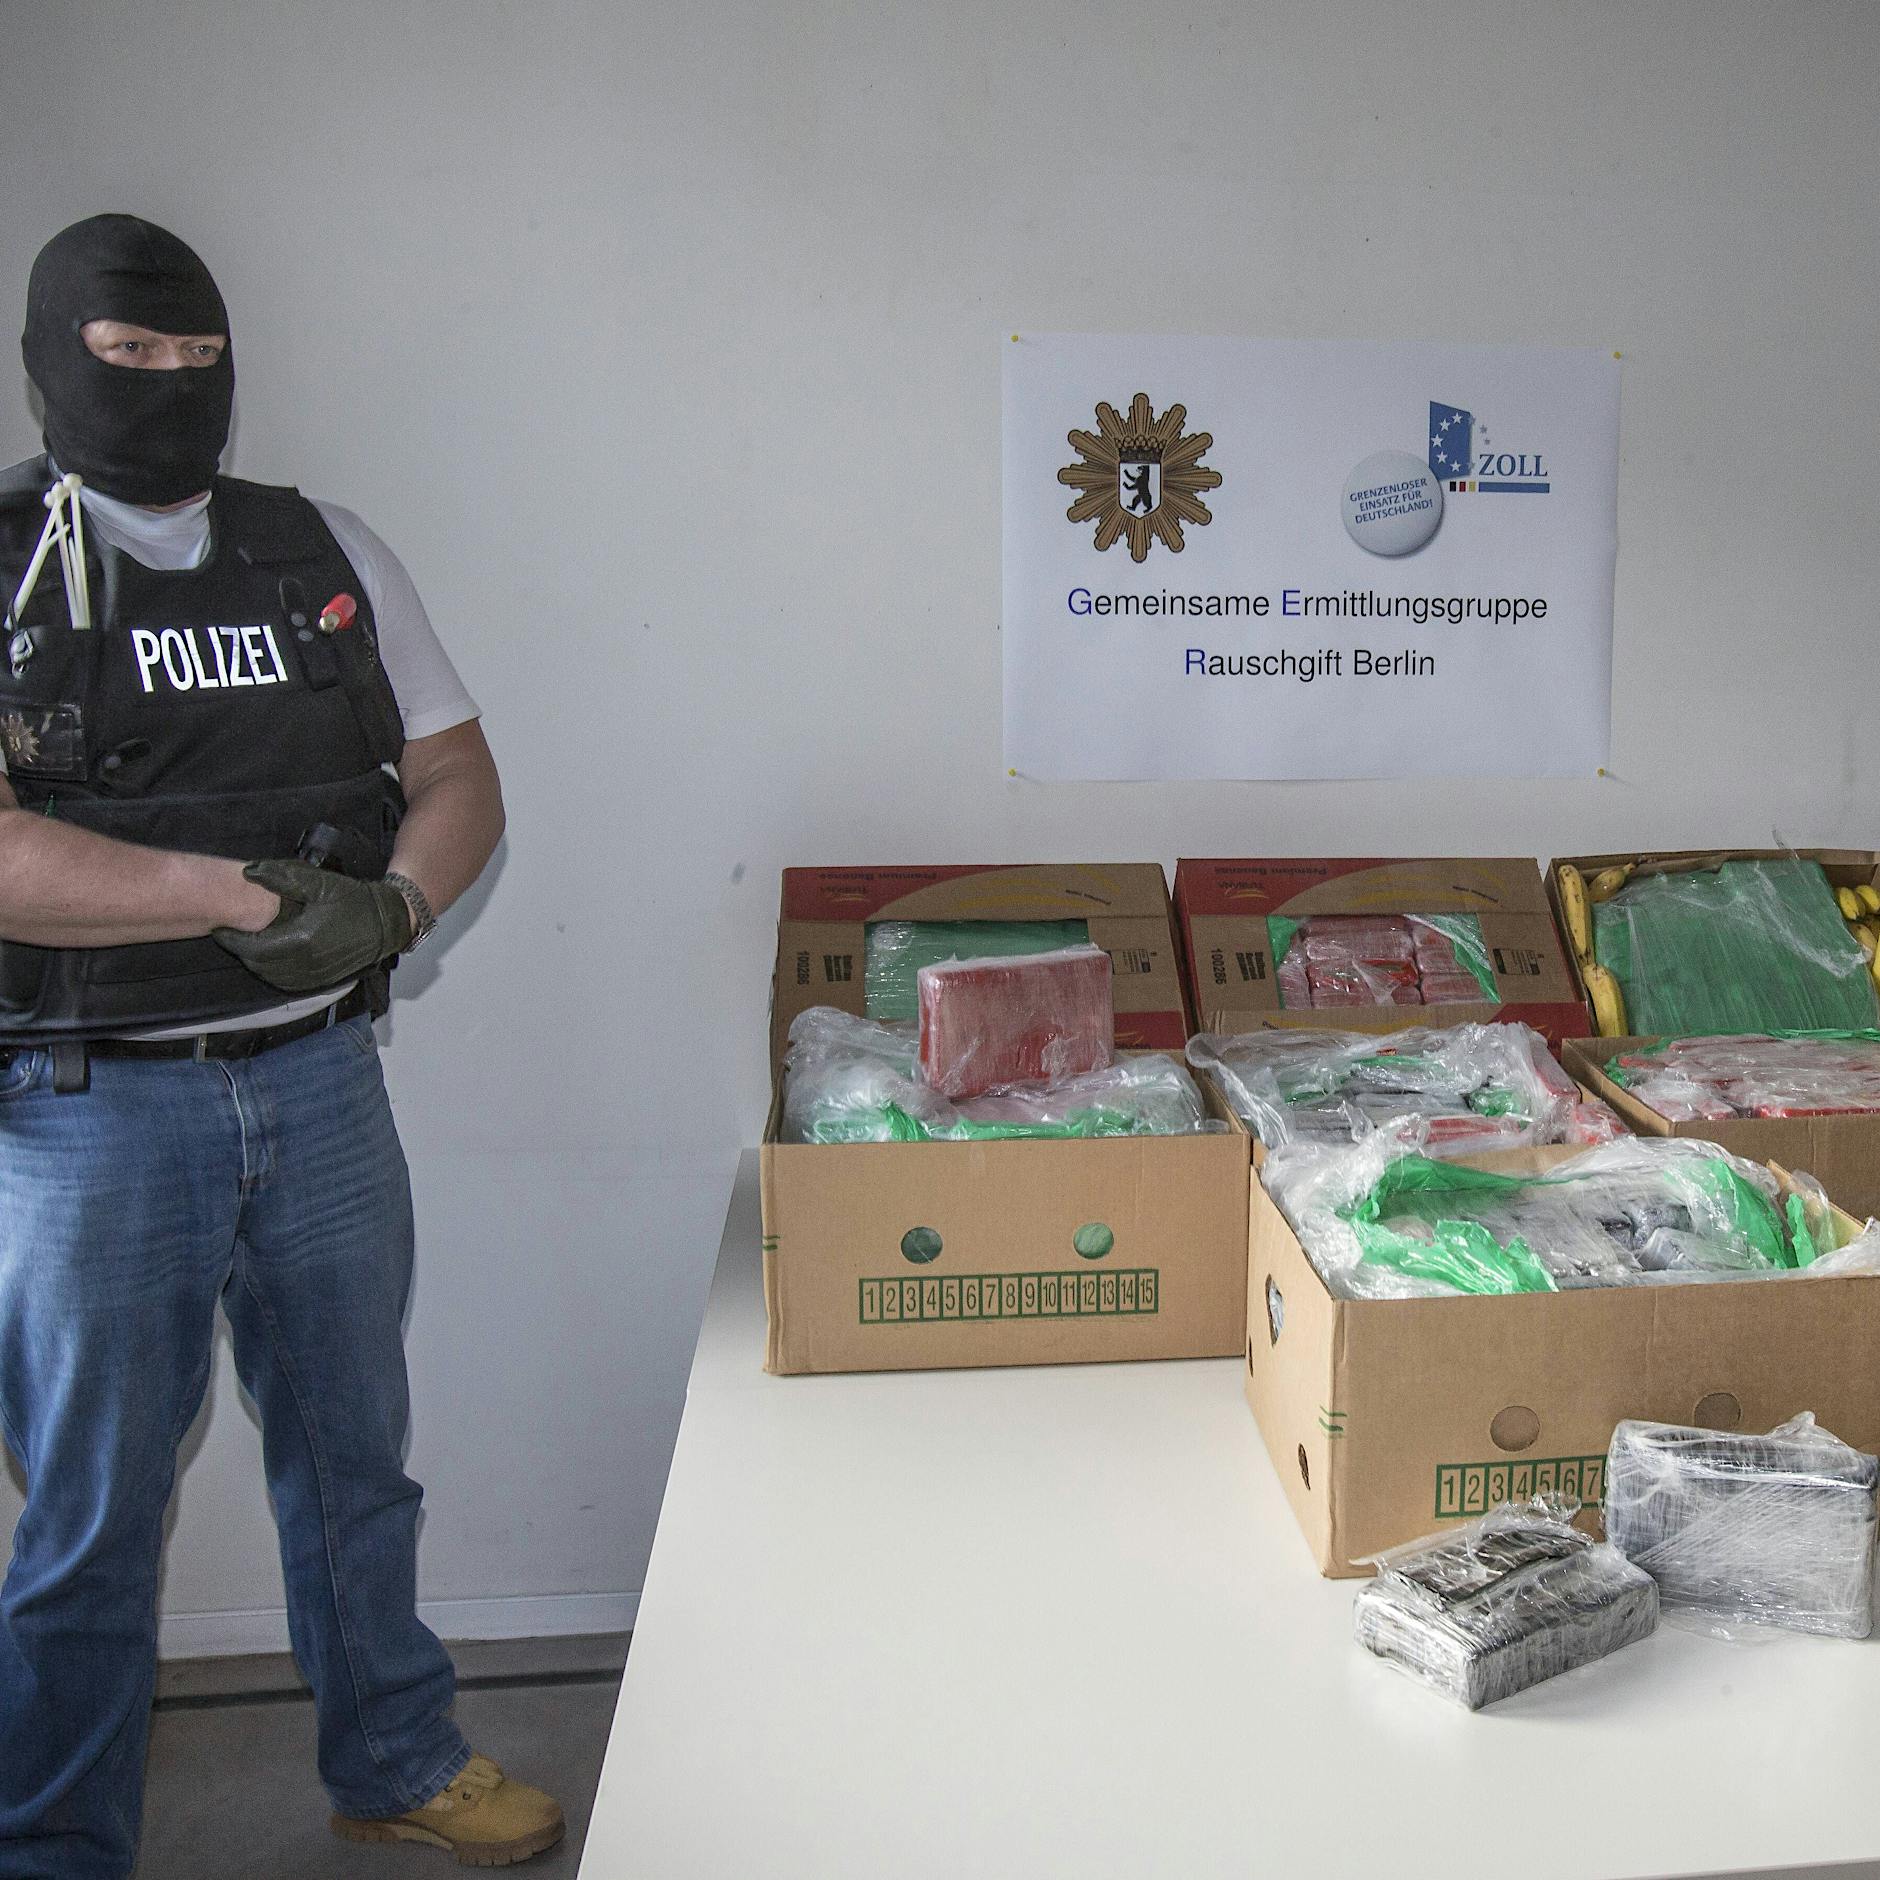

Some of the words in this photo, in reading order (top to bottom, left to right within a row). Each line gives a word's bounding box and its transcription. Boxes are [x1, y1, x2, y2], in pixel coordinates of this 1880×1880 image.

[1478, 454, 1548, 477] ZOLL
[1349, 478, 1427, 502] GRENZENLOSER
[1360, 495, 1400, 512] EINSATZ
[1402, 489, 1422, 502] FÜR
[1355, 499, 1433, 524] DEUTSCHLAND!
[1067, 588, 1270, 617] Gemeinsame
[1282, 589, 1548, 625] Ermittlungsgruppe
[131, 624, 288, 693] POLIZEI
[1186, 649, 1342, 683] Rauschgift
[1354, 649, 1435, 676] Berlin
[866, 1288, 874, 1312] 1
[886, 1287, 896, 1312] 2
[906, 1287, 916, 1312] 3
[926, 1286, 936, 1311] 4
[945, 1286, 955, 1310] 5
[966, 1285, 976, 1310] 6
[986, 1284, 996, 1309] 7
[1006, 1283, 1016, 1308] 8
[1025, 1283, 1035, 1308] 9
[1043, 1282, 1056, 1307] 10
[1063, 1281, 1075, 1306] 11
[1082, 1281, 1095, 1306] 12
[1102, 1280, 1115, 1305] 13
[1121, 1279, 1134, 1305] 14
[1141, 1278, 1153, 1304] 15
[1444, 1475, 1454, 1506] 1
[1468, 1475, 1480, 1504] 2
[1492, 1473, 1504, 1502] 3
[1516, 1472, 1528, 1500] 4
[1540, 1470, 1550, 1491] 5
[1563, 1468, 1575, 1495] 6
[1587, 1467, 1599, 1496] 7
